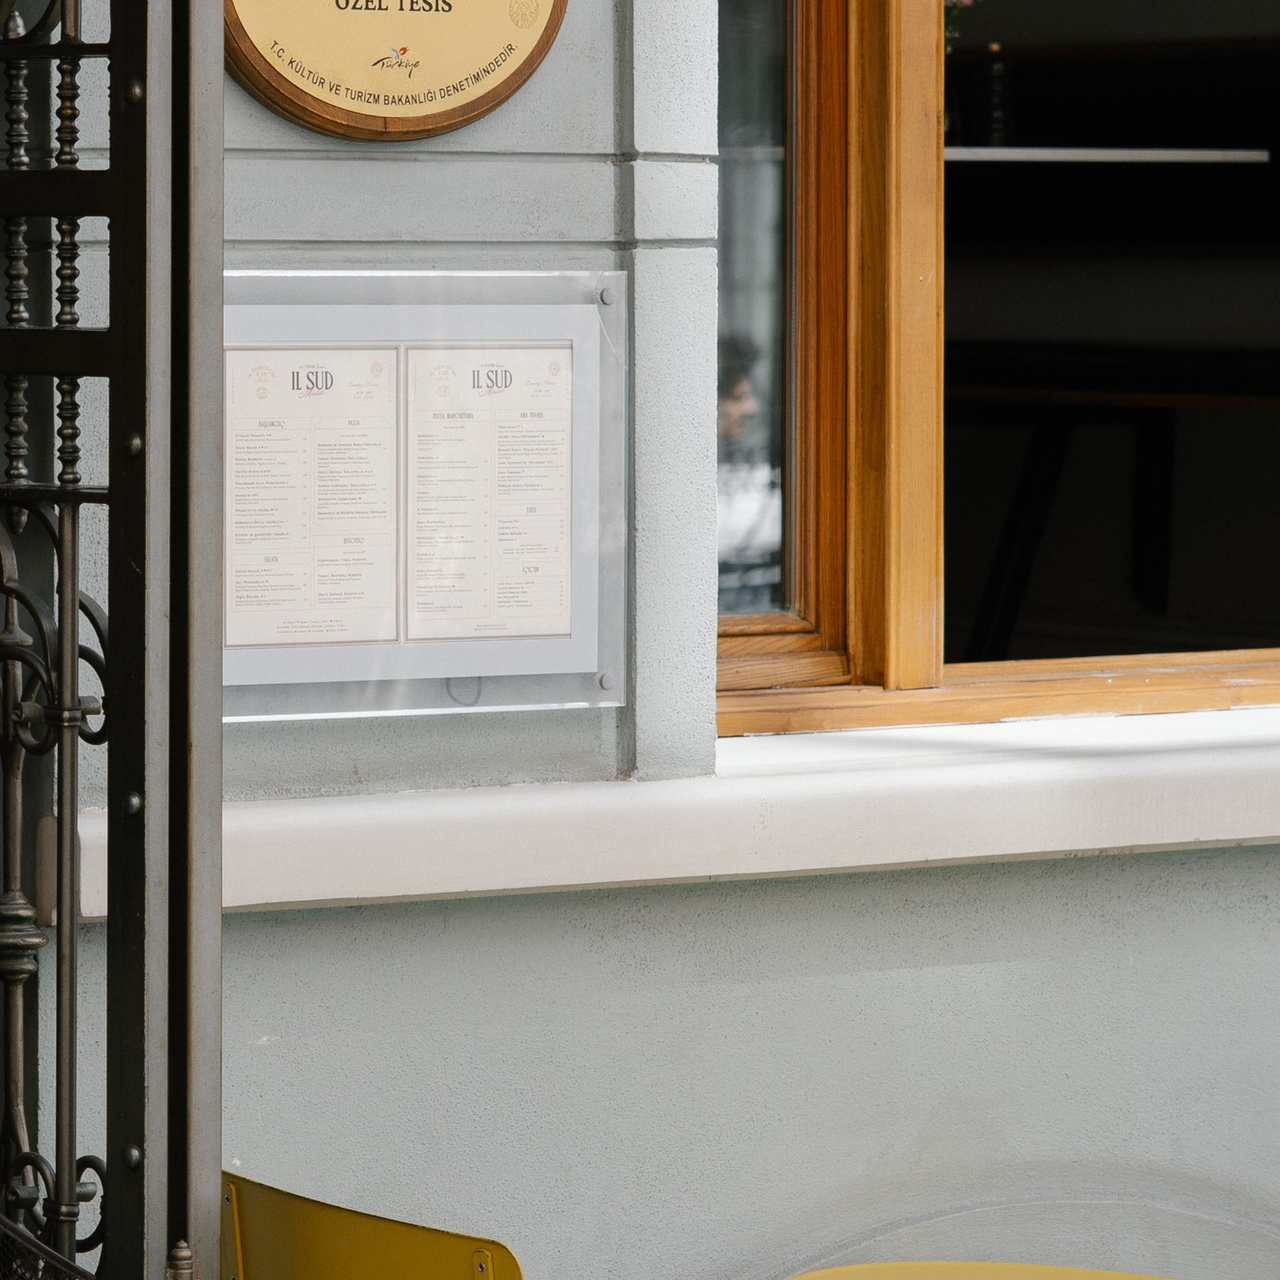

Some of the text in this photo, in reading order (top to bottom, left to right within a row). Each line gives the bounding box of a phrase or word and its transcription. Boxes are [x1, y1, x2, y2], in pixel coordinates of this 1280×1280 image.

[270, 40, 518, 105] T.C. KÜLTÜR VE TURİZM BAKANLIĞI DENETİMİNDEDİR.
[371, 56, 420, 78] Türkiye
[291, 371, 302, 390] IL
[305, 371, 334, 390] SUD
[472, 369, 483, 389] IL
[486, 369, 513, 389] SUD
